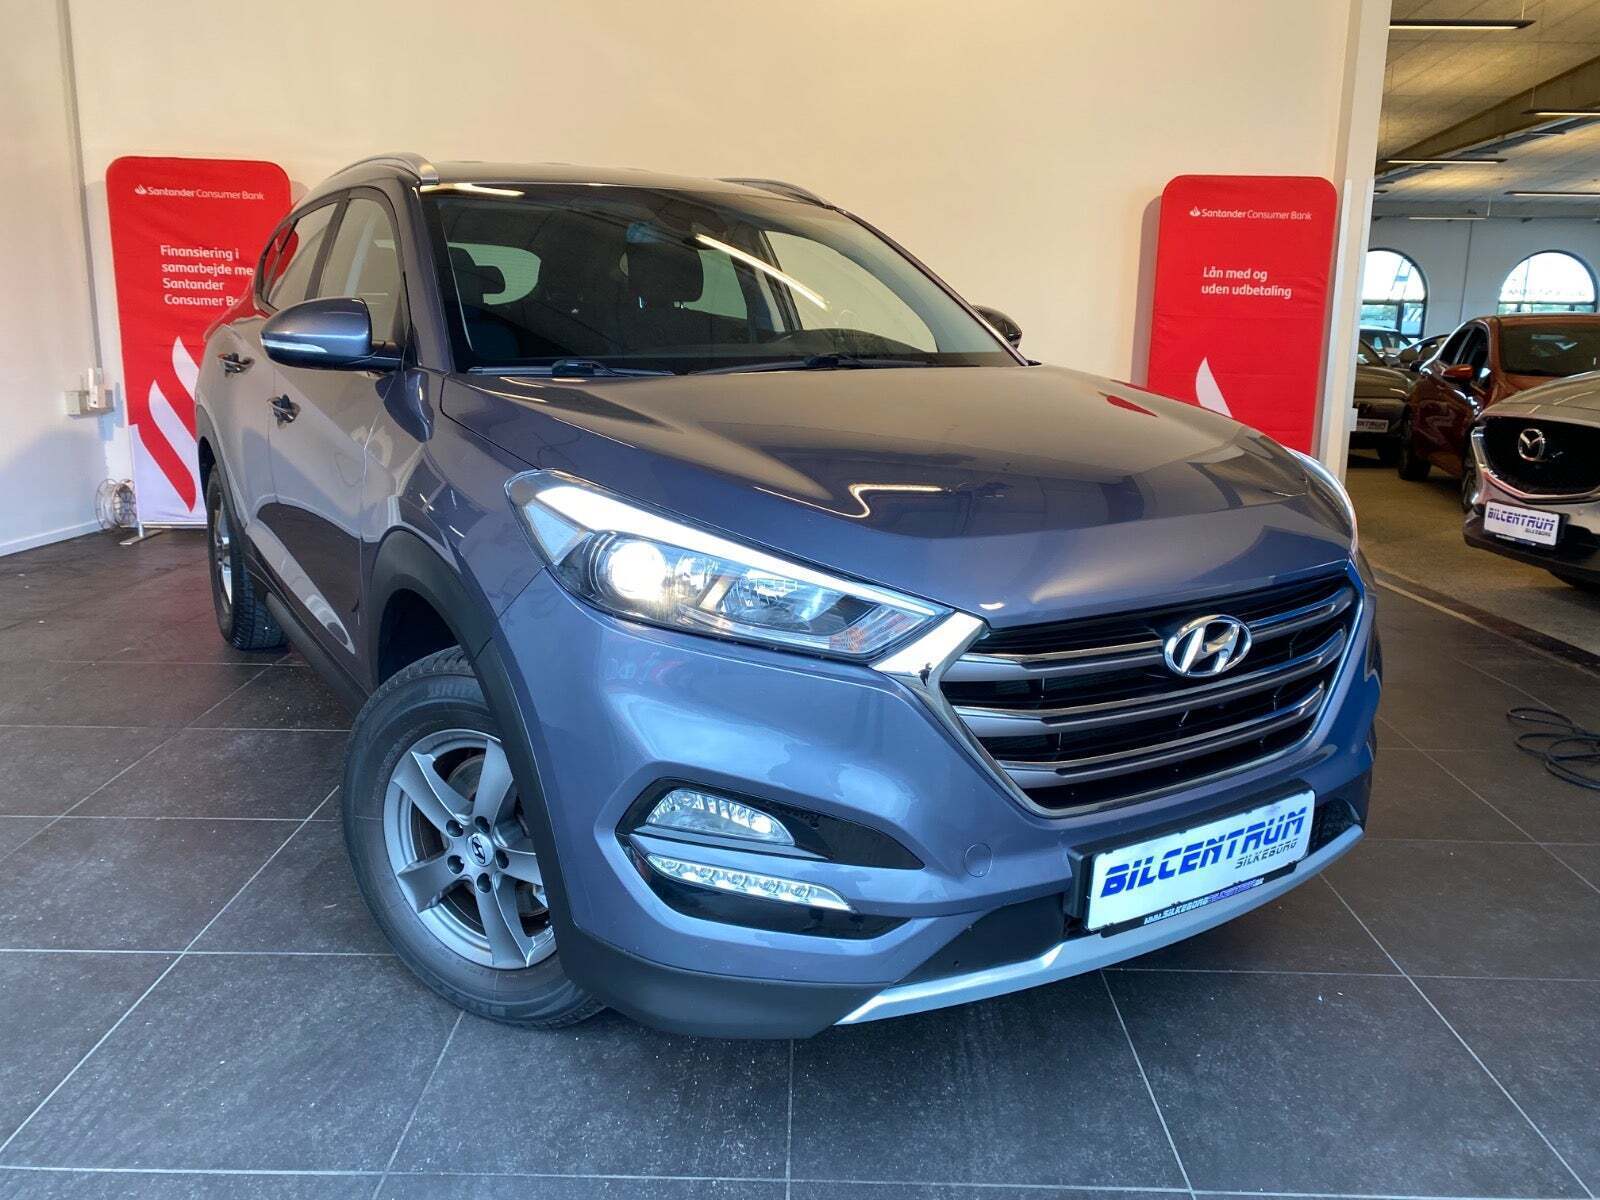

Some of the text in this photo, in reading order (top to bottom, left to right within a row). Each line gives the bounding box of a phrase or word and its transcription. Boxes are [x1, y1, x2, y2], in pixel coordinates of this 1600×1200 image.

[147, 186, 264, 200] Santander Consumer Bank
[1201, 208, 1312, 220] Santander Consumer Bank
[160, 245, 239, 261] Finansiering i
[161, 263, 254, 277] samarbejde me
[1203, 265, 1268, 283] Lån med og
[162, 278, 225, 290] Santander
[1201, 283, 1292, 300] uden udbetaling
[164, 294, 223, 306] Consumer
[1487, 507, 1556, 532] BILCENTRUM
[1100, 806, 1308, 898] BILCENTRUM
[1234, 838, 1298, 869] SILKEBORG
